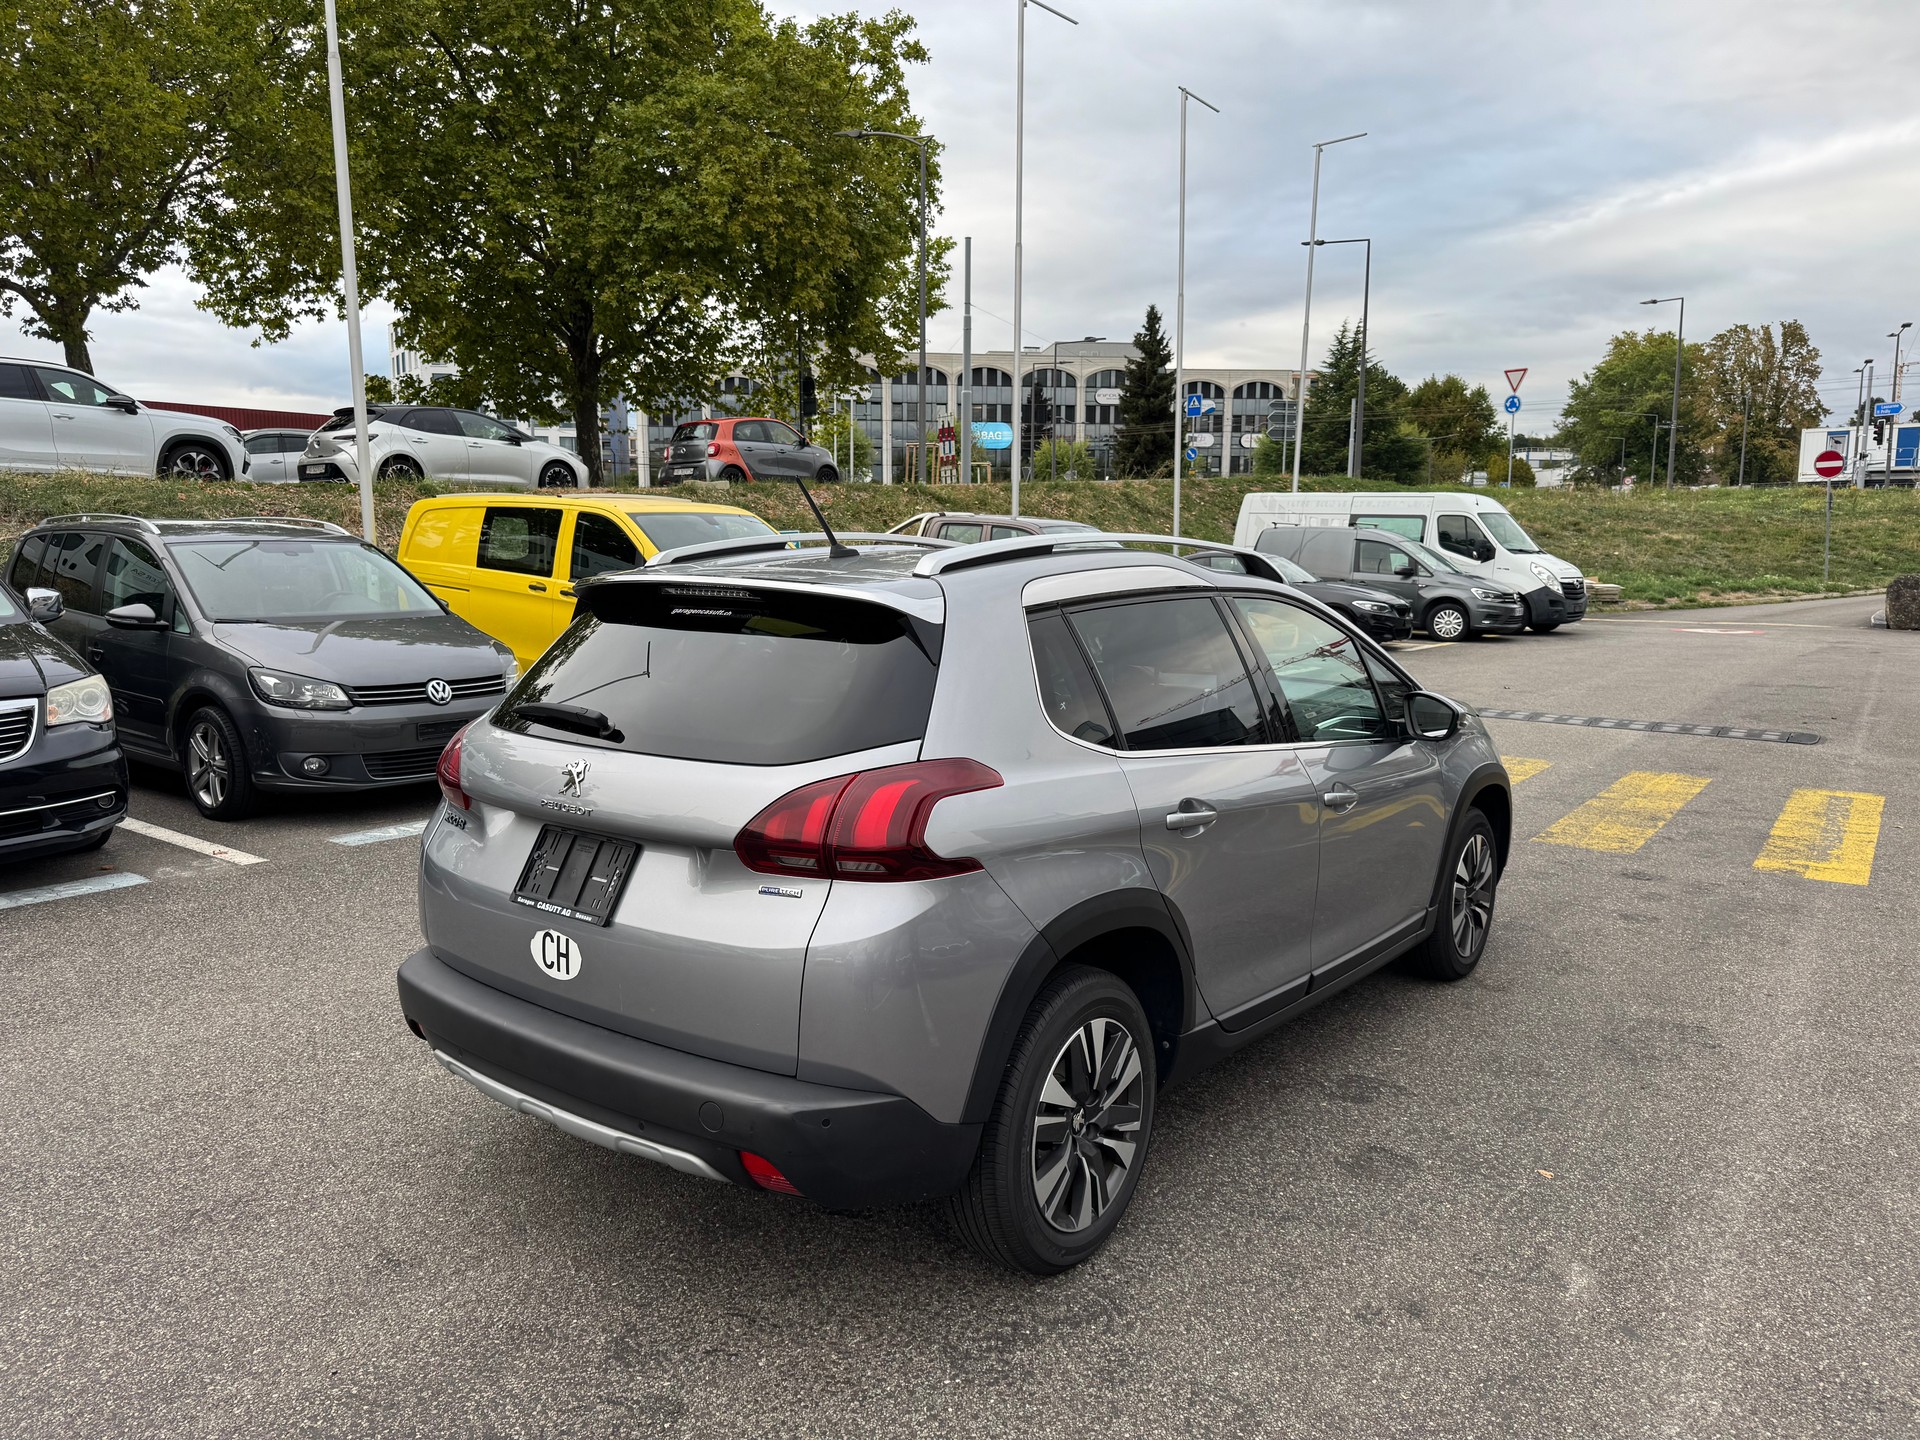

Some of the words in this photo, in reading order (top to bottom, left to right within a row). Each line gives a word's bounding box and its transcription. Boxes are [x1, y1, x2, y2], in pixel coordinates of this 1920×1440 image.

[541, 799, 594, 817] PEUGEOT
[445, 811, 467, 830] 2008
[536, 901, 562, 914] CASUTT
[561, 908, 572, 917] AG
[542, 931, 570, 975] CH
